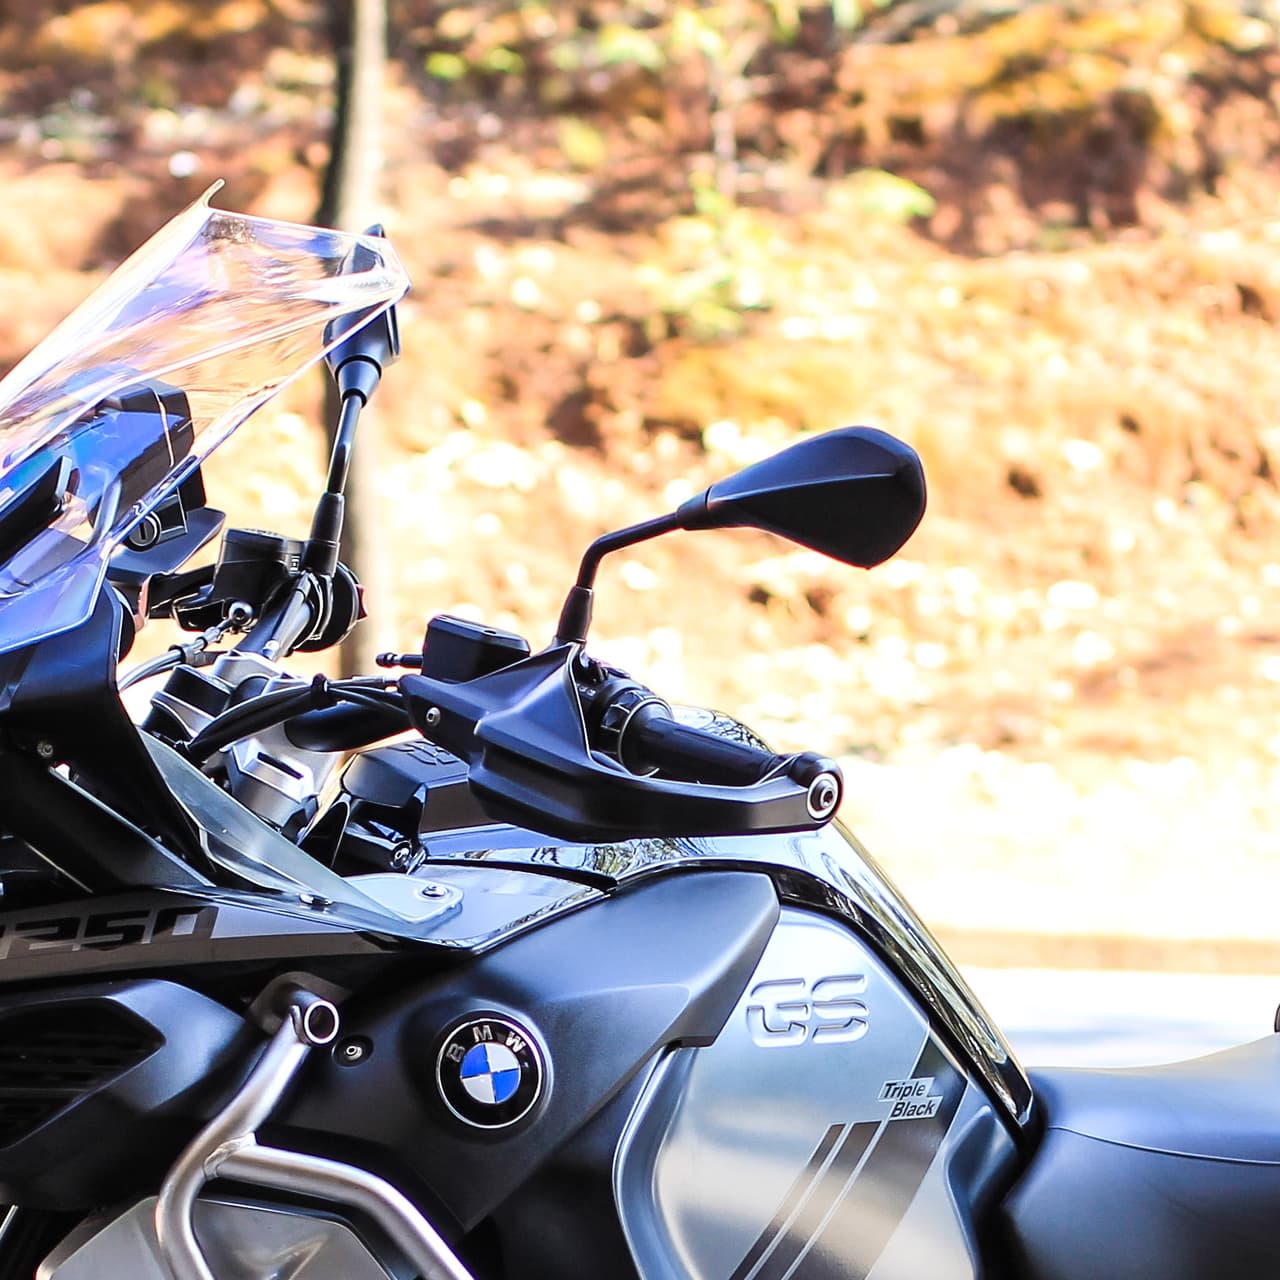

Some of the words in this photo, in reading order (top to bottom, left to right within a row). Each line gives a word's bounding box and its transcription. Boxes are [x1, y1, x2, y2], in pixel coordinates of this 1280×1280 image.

[746, 974, 869, 1048] GS
[446, 1025, 526, 1063] BMW
[883, 1081, 926, 1101] Triple
[890, 1100, 935, 1118] Black
